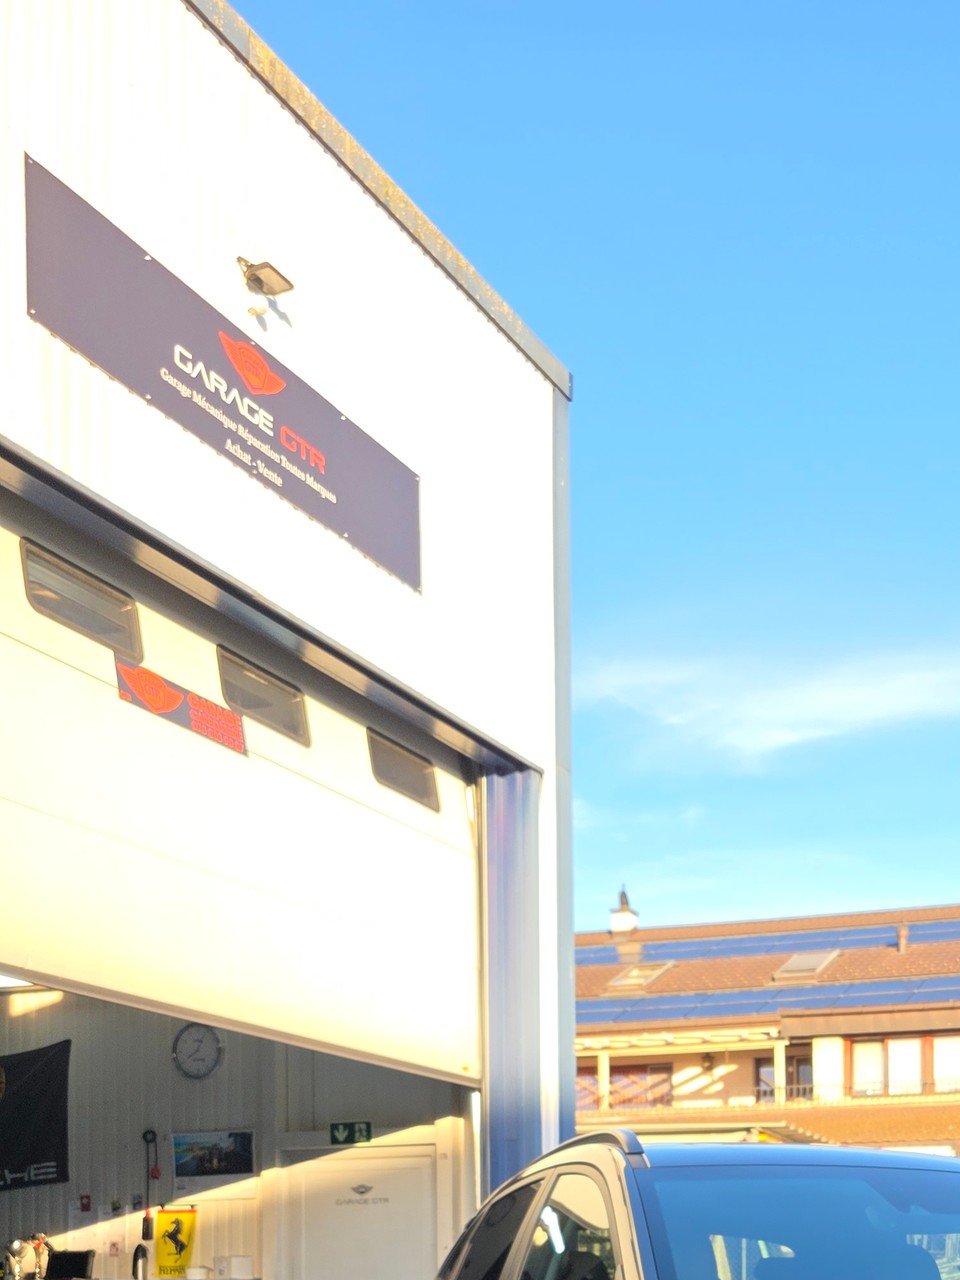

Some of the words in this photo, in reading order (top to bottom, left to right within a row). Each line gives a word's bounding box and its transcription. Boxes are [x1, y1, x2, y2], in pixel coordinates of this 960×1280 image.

[160, 368, 192, 398] Garage
[192, 390, 238, 429] Mécanique
[237, 424, 281, 464] Réparation
[174, 344, 274, 437] GARAGE
[280, 425, 326, 475] GTR
[225, 438, 252, 466] Achat
[257, 460, 283, 487] Vente
